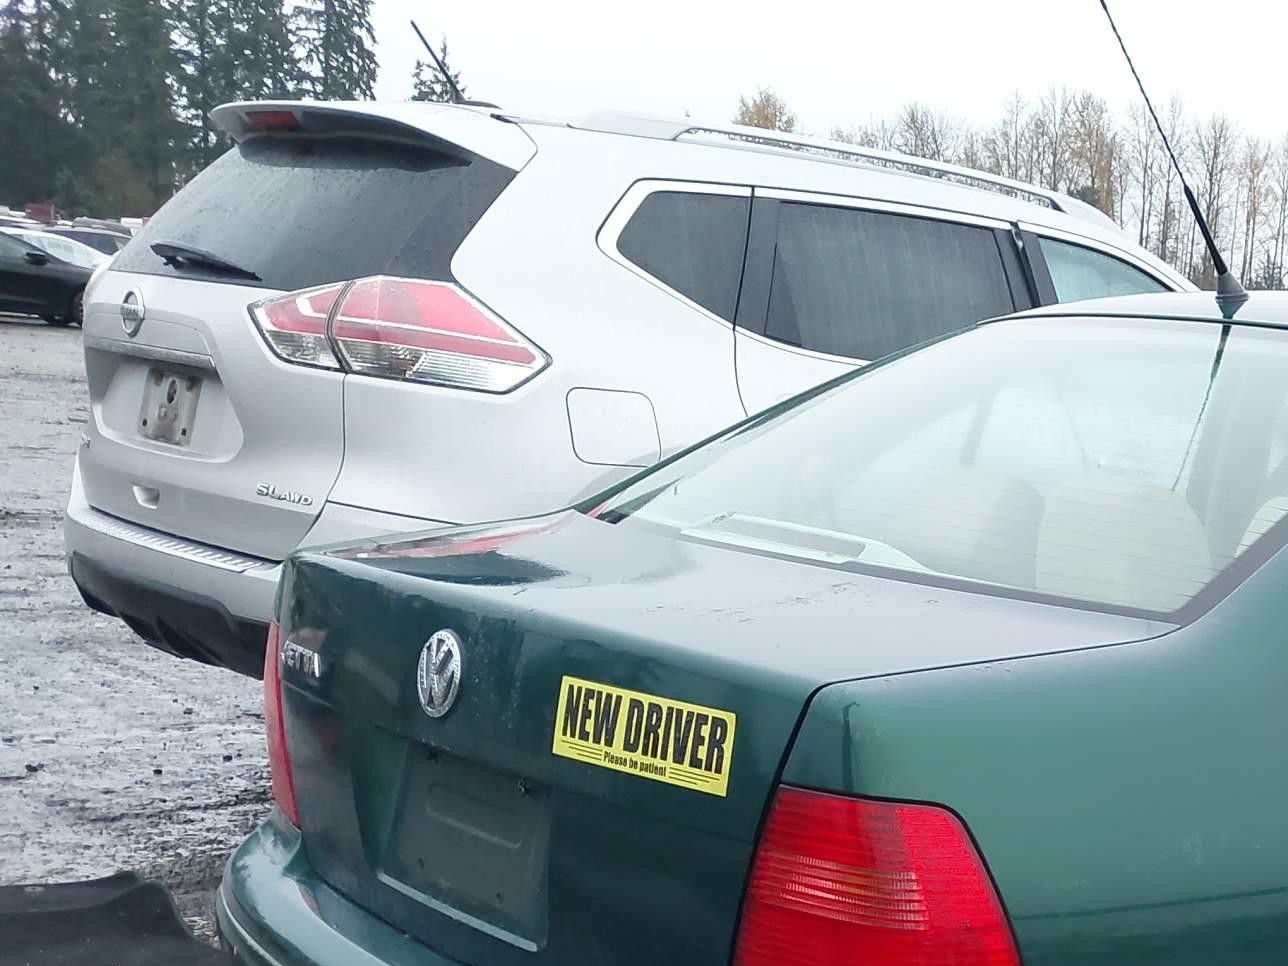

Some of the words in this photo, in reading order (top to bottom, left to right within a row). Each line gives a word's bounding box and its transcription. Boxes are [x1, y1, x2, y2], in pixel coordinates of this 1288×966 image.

[562, 684, 622, 748] NEW
[623, 698, 728, 774] DRIVER
[603, 751, 628, 767] Please
[629, 757, 639, 770] be
[639, 761, 667, 777] patient
